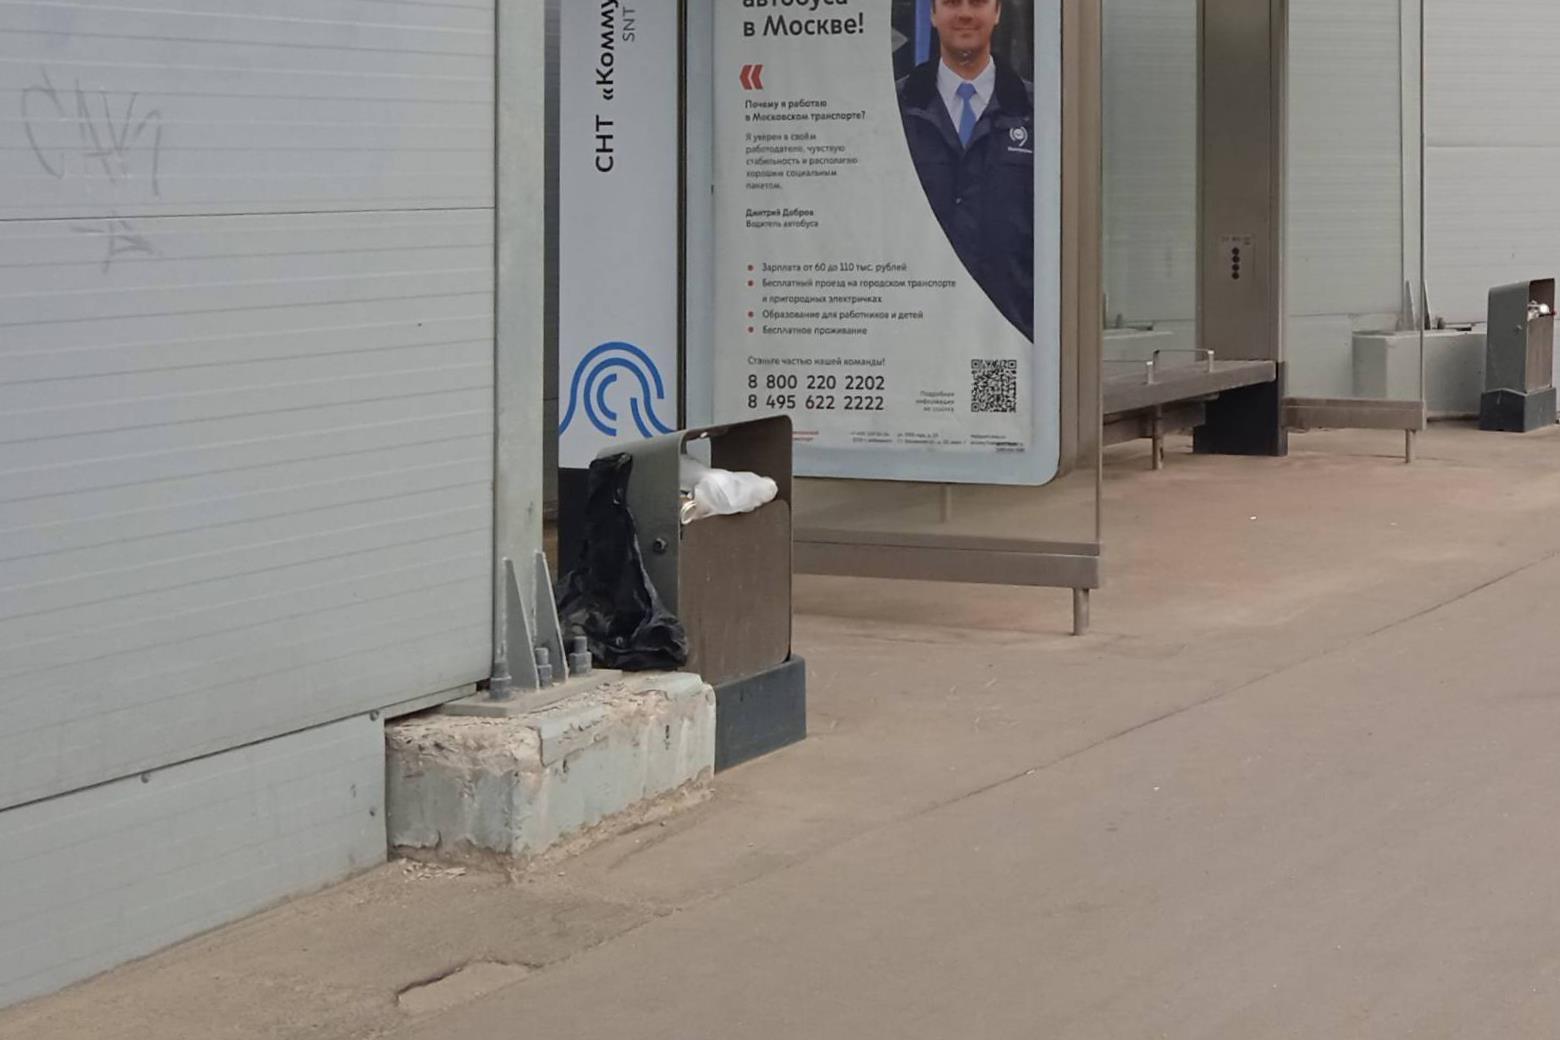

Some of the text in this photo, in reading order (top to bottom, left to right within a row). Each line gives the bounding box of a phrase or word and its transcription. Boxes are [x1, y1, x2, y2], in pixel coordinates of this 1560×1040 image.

[622, 8, 635, 42] SNT
[743, 12, 865, 37] в Москве!
[745, 99, 779, 110] Почему
[788, 99, 827, 110] работаю
[752, 113, 809, 122] Московском
[811, 110, 866, 122] транспорте?
[595, 115, 614, 173] СНТ
[762, 263, 801, 273] Зарплата
[803, 264, 812, 272] от
[814, 263, 826, 271] 60
[827, 264, 838, 272] до
[839, 263, 855, 271] 110
[875, 262, 907, 273] рублей
[762, 278, 813, 288] Бесплатный
[815, 279, 846, 289] проезд
[859, 279, 906, 289] городском
[907, 279, 957, 290] транспорте
[769, 295, 827, 305] пригородных
[828, 295, 882, 305] электричках
[762, 309, 820, 320] Образование
[839, 309, 889, 320] работников
[898, 310, 924, 320] детей
[762, 326, 868, 336] Бесплатное проживание
[782, 357, 812, 365] частью
[814, 357, 842, 365] нашей
[843, 357, 886, 367] команды!
[747, 374, 885, 391] 8 800 220 2202
[747, 394, 885, 411] 8 495 622 2222
